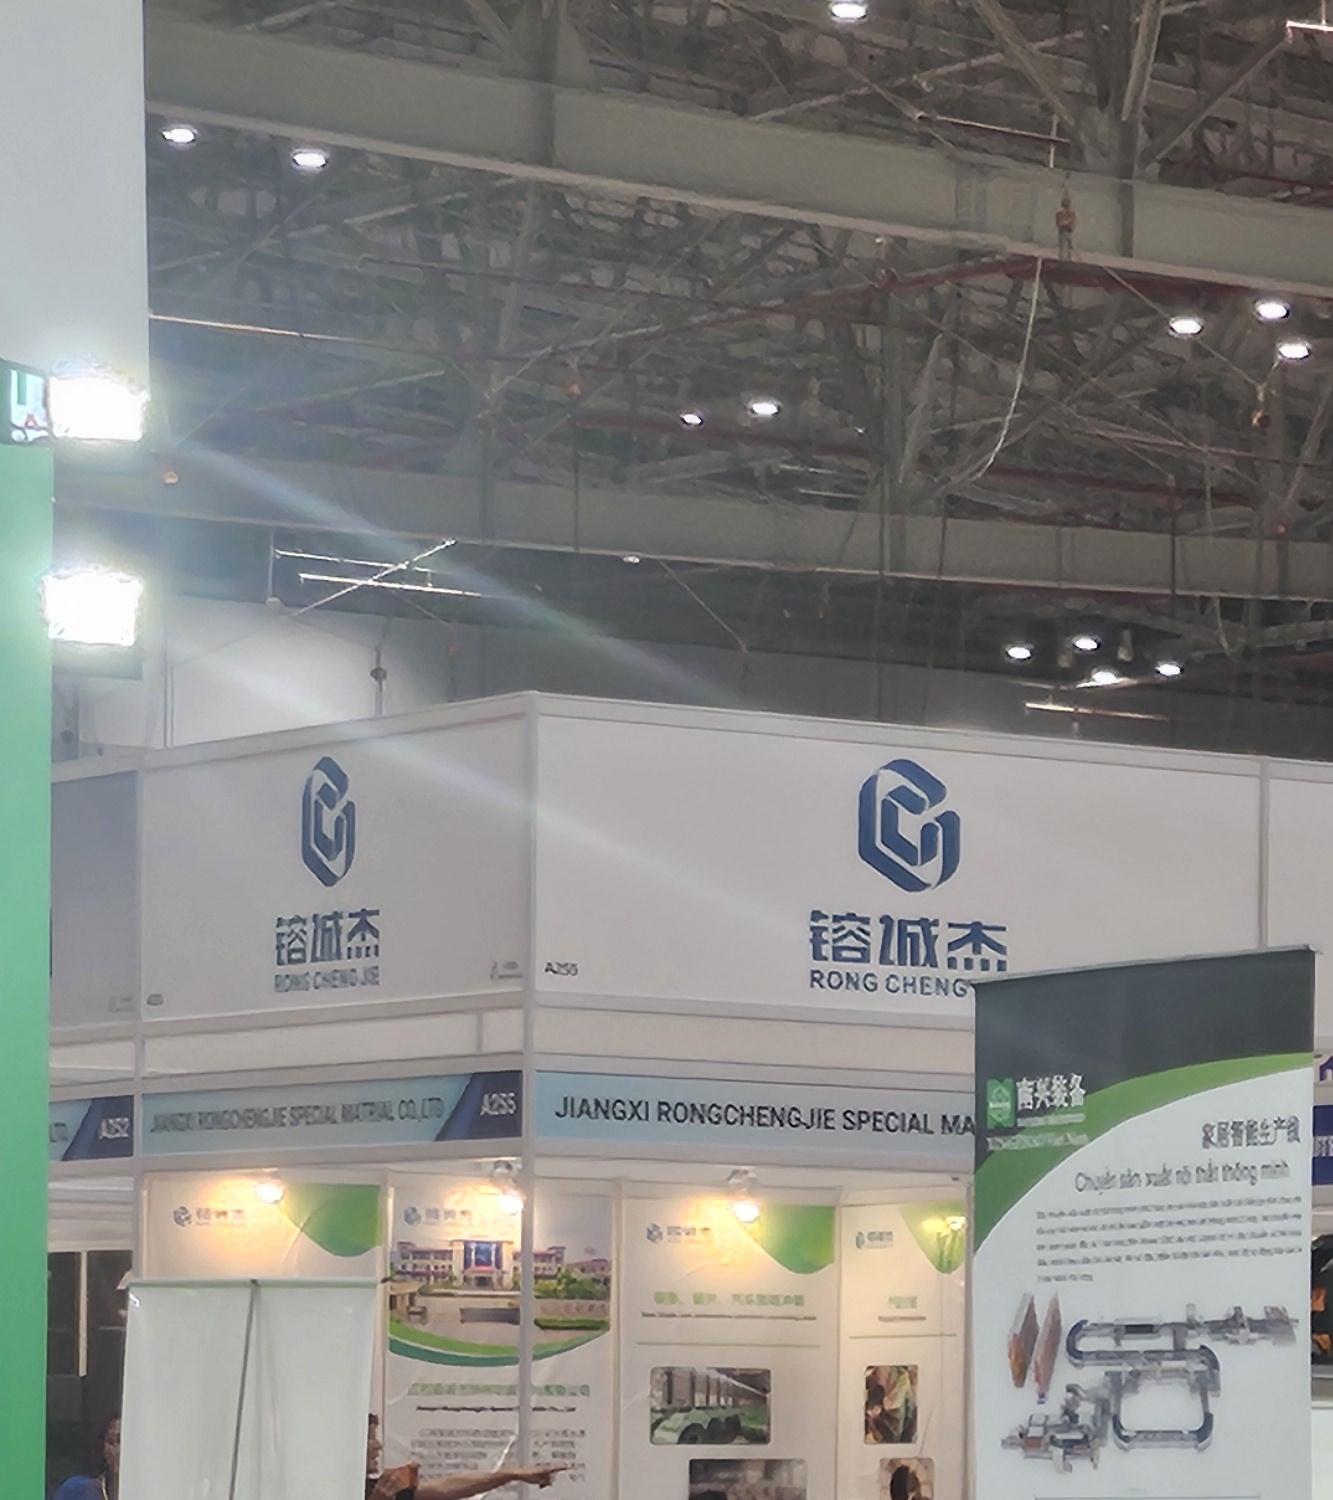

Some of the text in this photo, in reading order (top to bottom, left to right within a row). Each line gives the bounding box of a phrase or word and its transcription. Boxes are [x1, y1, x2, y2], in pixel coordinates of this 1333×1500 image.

[276, 908, 380, 965] 镕诚杰
[809, 910, 1007, 972] 镕诚杰
[810, 969, 968, 997] RONG CHENG
[555, 1097, 650, 1122] JIANGXI
[657, 1101, 836, 1131] RONGCHENGJIE
[843, 1110, 935, 1135] SPECIAL
